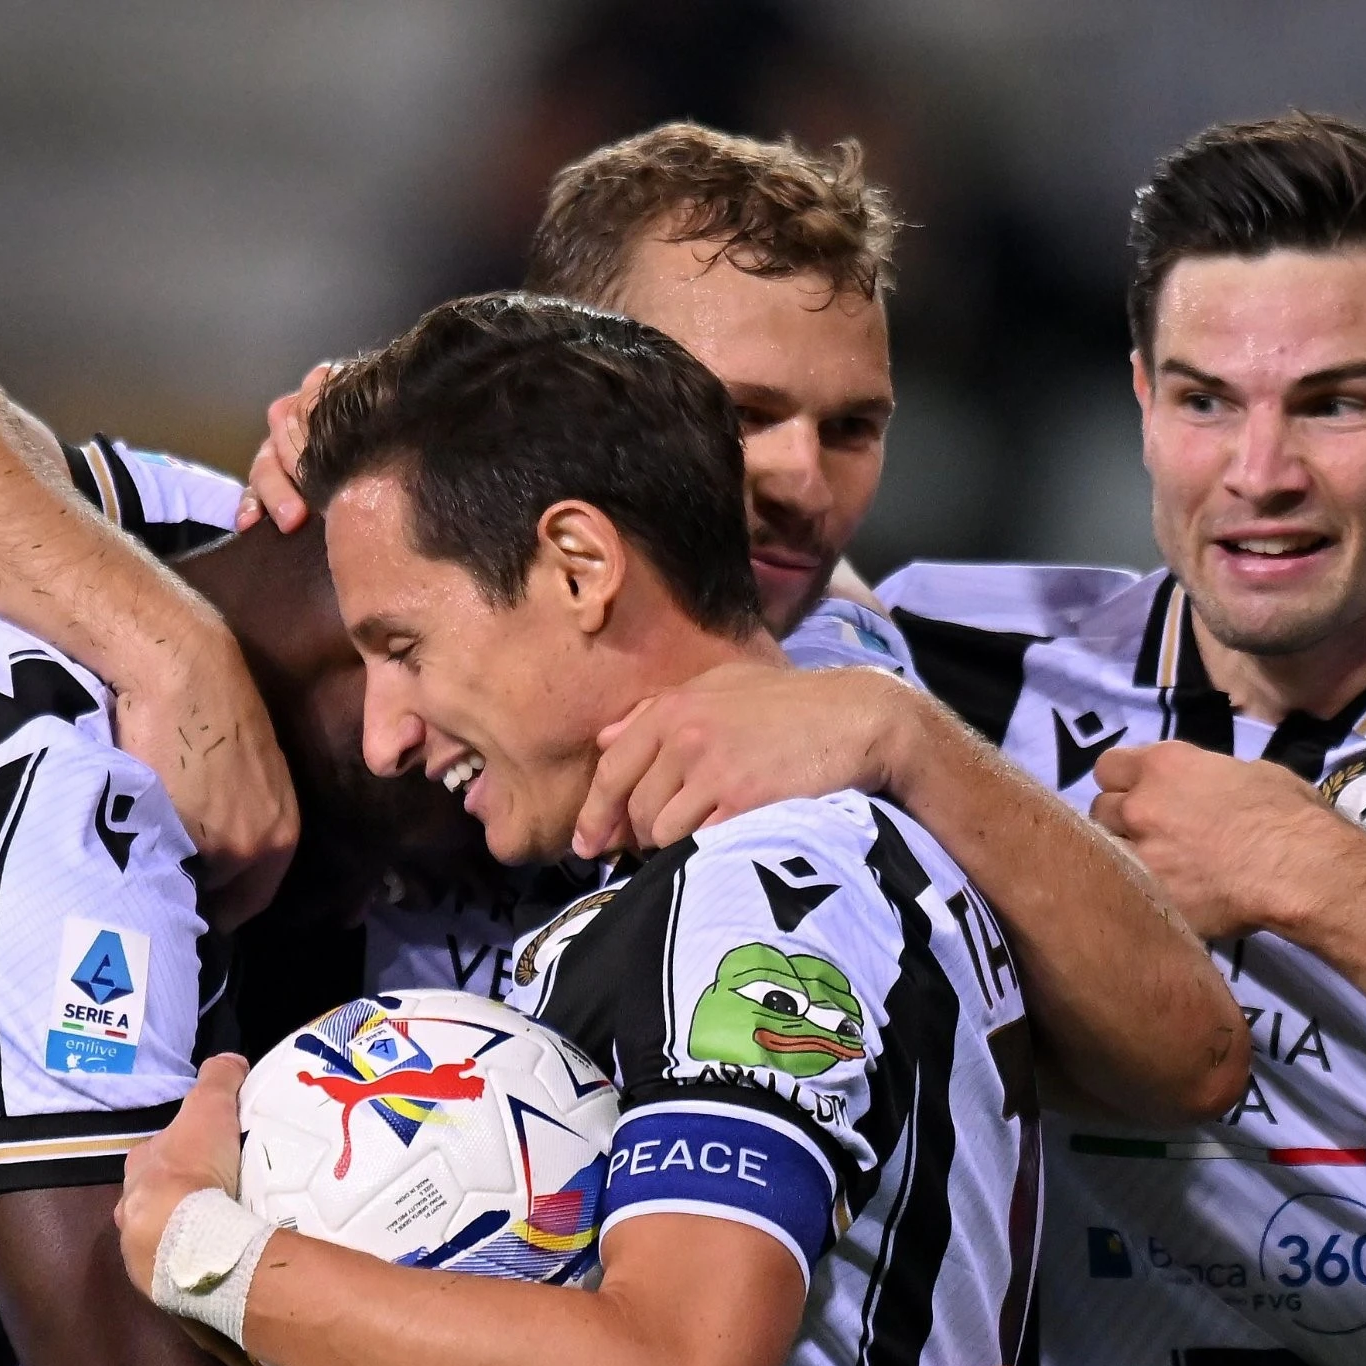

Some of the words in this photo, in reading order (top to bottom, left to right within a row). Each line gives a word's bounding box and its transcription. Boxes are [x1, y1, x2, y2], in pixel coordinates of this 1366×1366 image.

[63, 1003, 114, 1026] SERIE
[117, 1013, 129, 1029] A
[65, 1037, 117, 1058] enilive
[606, 1139, 769, 1190] PEACE
[1253, 1293, 1303, 1313] FVG
